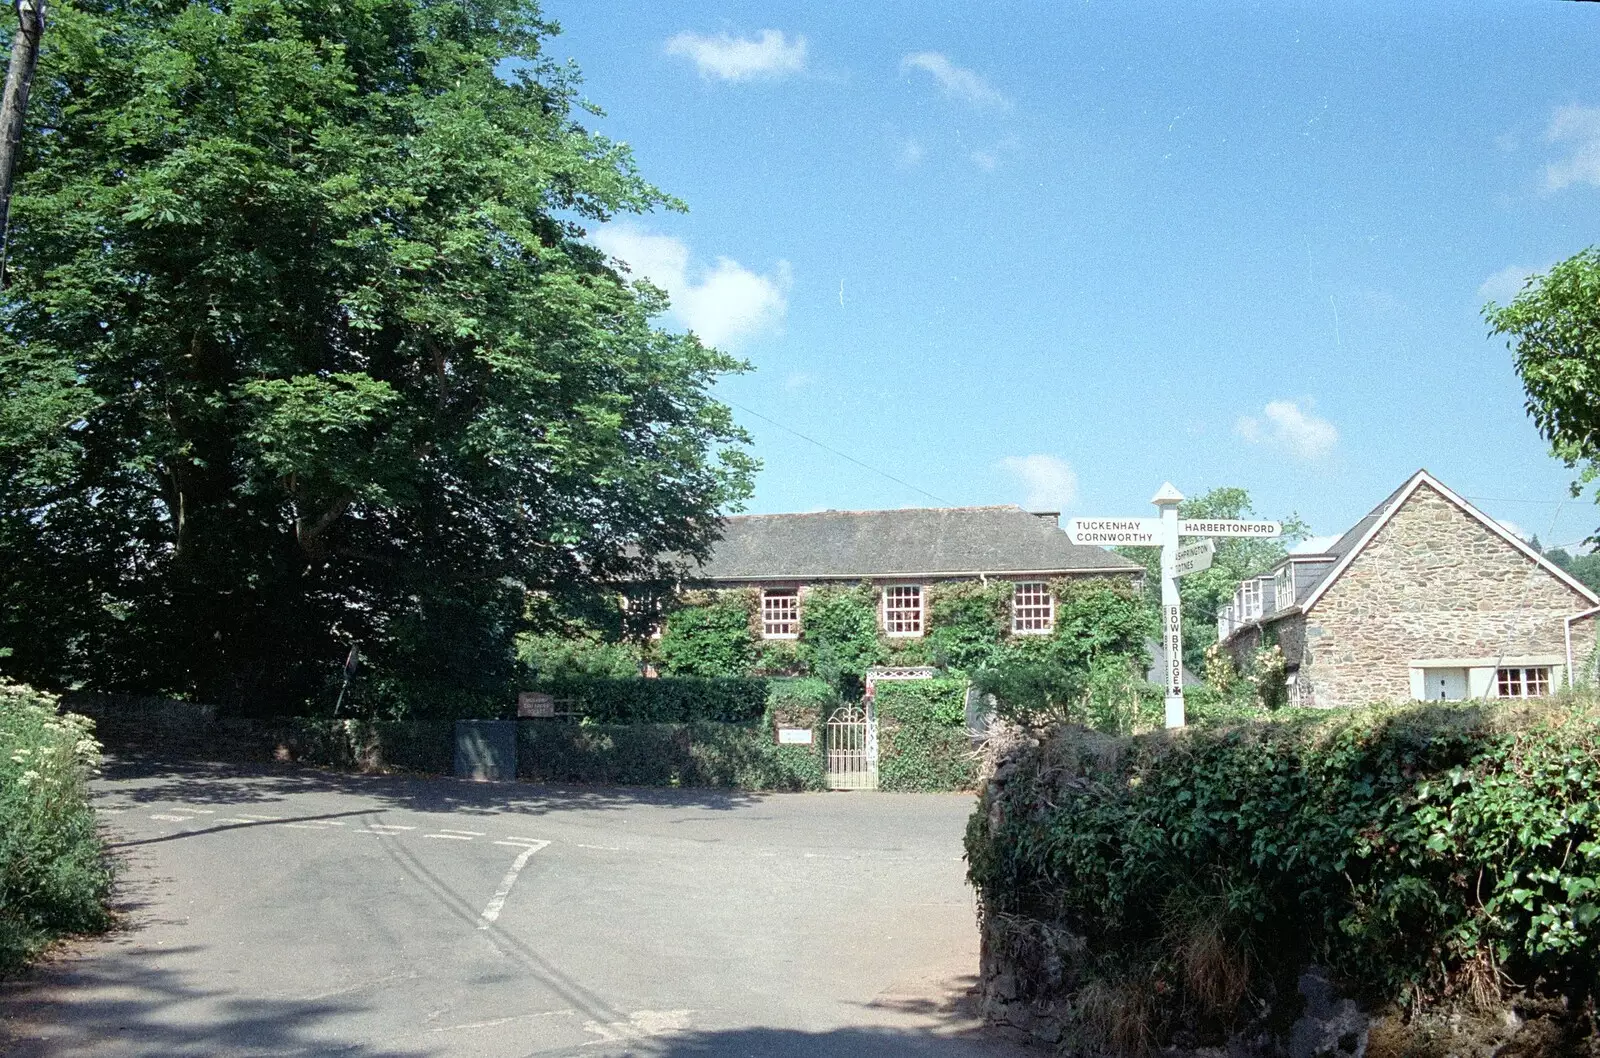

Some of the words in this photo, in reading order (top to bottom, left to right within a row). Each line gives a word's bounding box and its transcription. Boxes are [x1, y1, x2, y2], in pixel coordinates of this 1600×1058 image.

[1076, 521, 1141, 531] TUCKENHAY
[1184, 522, 1275, 534] HARBERTONFORD
[1076, 532, 1153, 542] CORNWORTHY
[1170, 607, 1179, 632] BOW
[1171, 635, 1180, 685] BRIDGE
